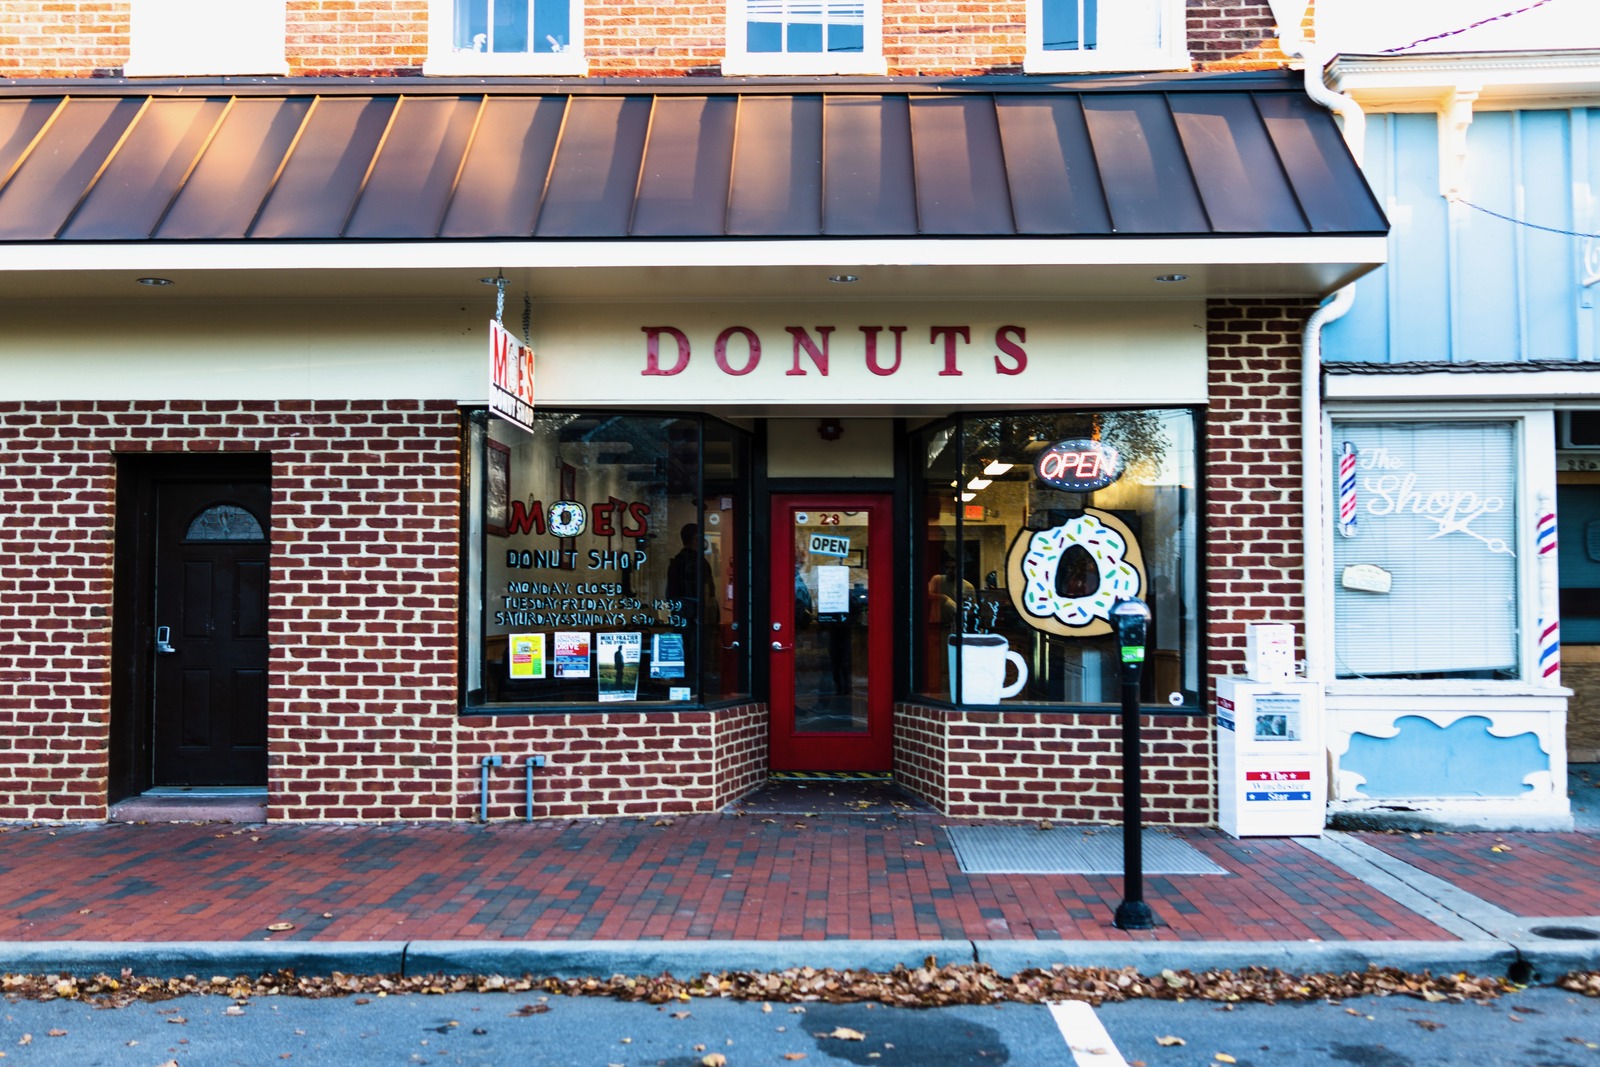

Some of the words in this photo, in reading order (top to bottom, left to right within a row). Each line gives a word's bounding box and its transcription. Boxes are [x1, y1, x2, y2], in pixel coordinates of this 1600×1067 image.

[641, 325, 1028, 377] DONUTS
[493, 326, 534, 405] MOE'S
[492, 386, 517, 419] DONUT
[517, 399, 534, 427] SHOP
[1040, 451, 1118, 479] OPEN
[1359, 447, 1404, 470] The
[1364, 471, 1486, 532] Shop
[508, 500, 650, 538] MOE'S
[820, 513, 840, 526] 28
[811, 537, 848, 554] OPEN
[506, 549, 579, 570] DONUT
[587, 549, 648, 571] SHOP
[576, 581, 623, 597] CLOSED
[1253, 782, 1305, 790] Winchester
[1268, 770, 1289, 781] The
[1268, 791, 1289, 801] Star
